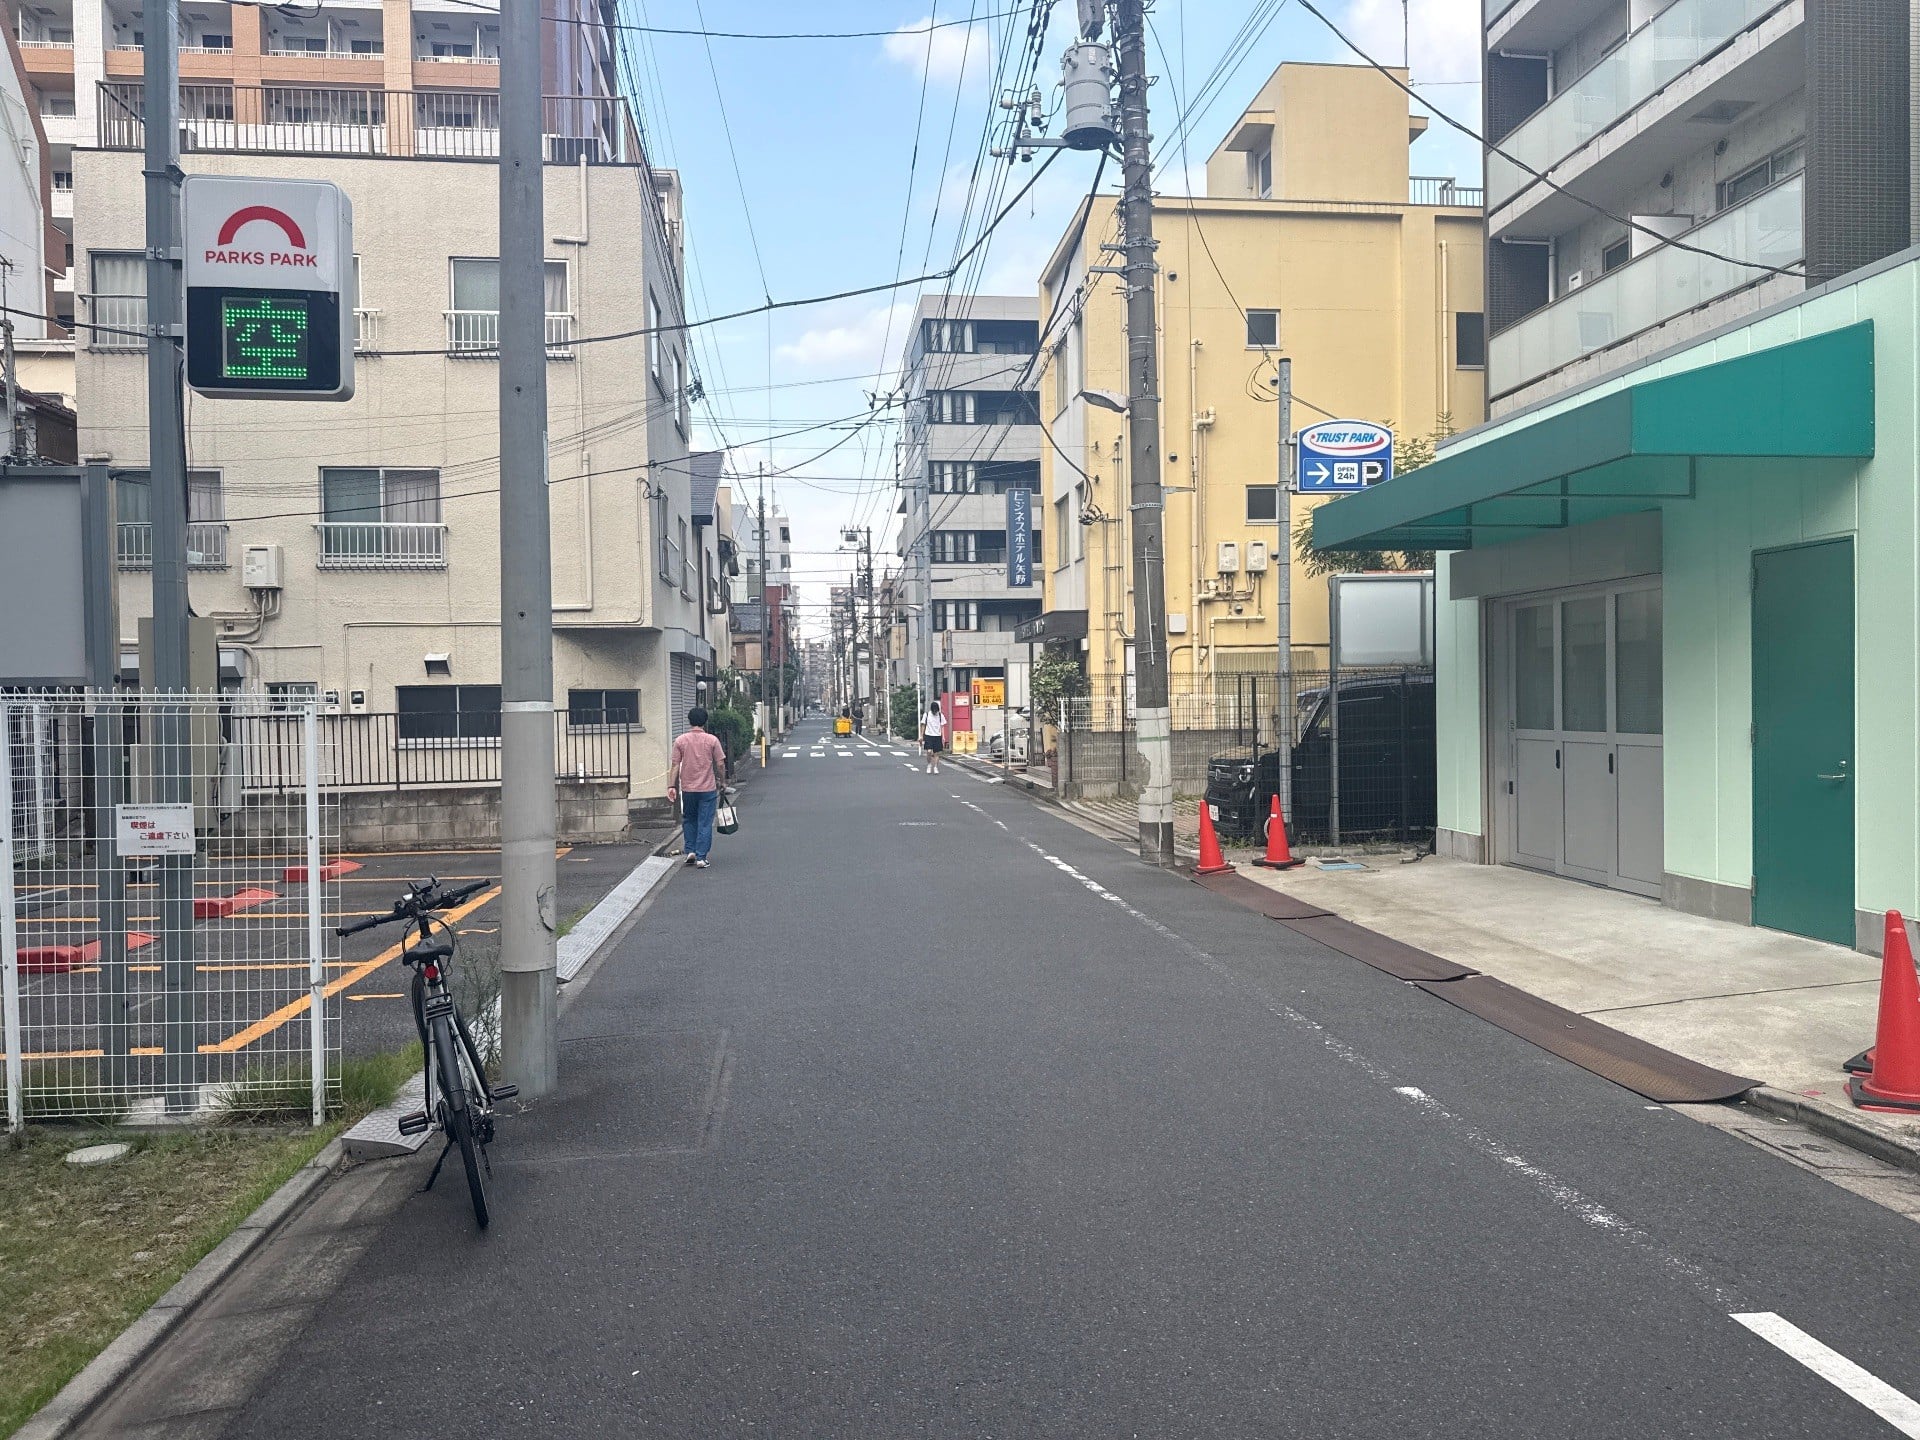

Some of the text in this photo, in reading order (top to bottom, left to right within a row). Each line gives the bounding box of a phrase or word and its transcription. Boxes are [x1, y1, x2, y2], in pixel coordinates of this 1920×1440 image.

[205, 250, 318, 268] PARKS PARK
[225, 299, 308, 377] 空
[1316, 432, 1377, 443] TRUST PARK
[1337, 472, 1355, 480] 24h
[1361, 461, 1384, 486] P
[1014, 490, 1027, 585] ビジネスホテル矢野
[130, 821, 156, 830] 喫煙は
[139, 831, 190, 841] ご遠慮下さい
